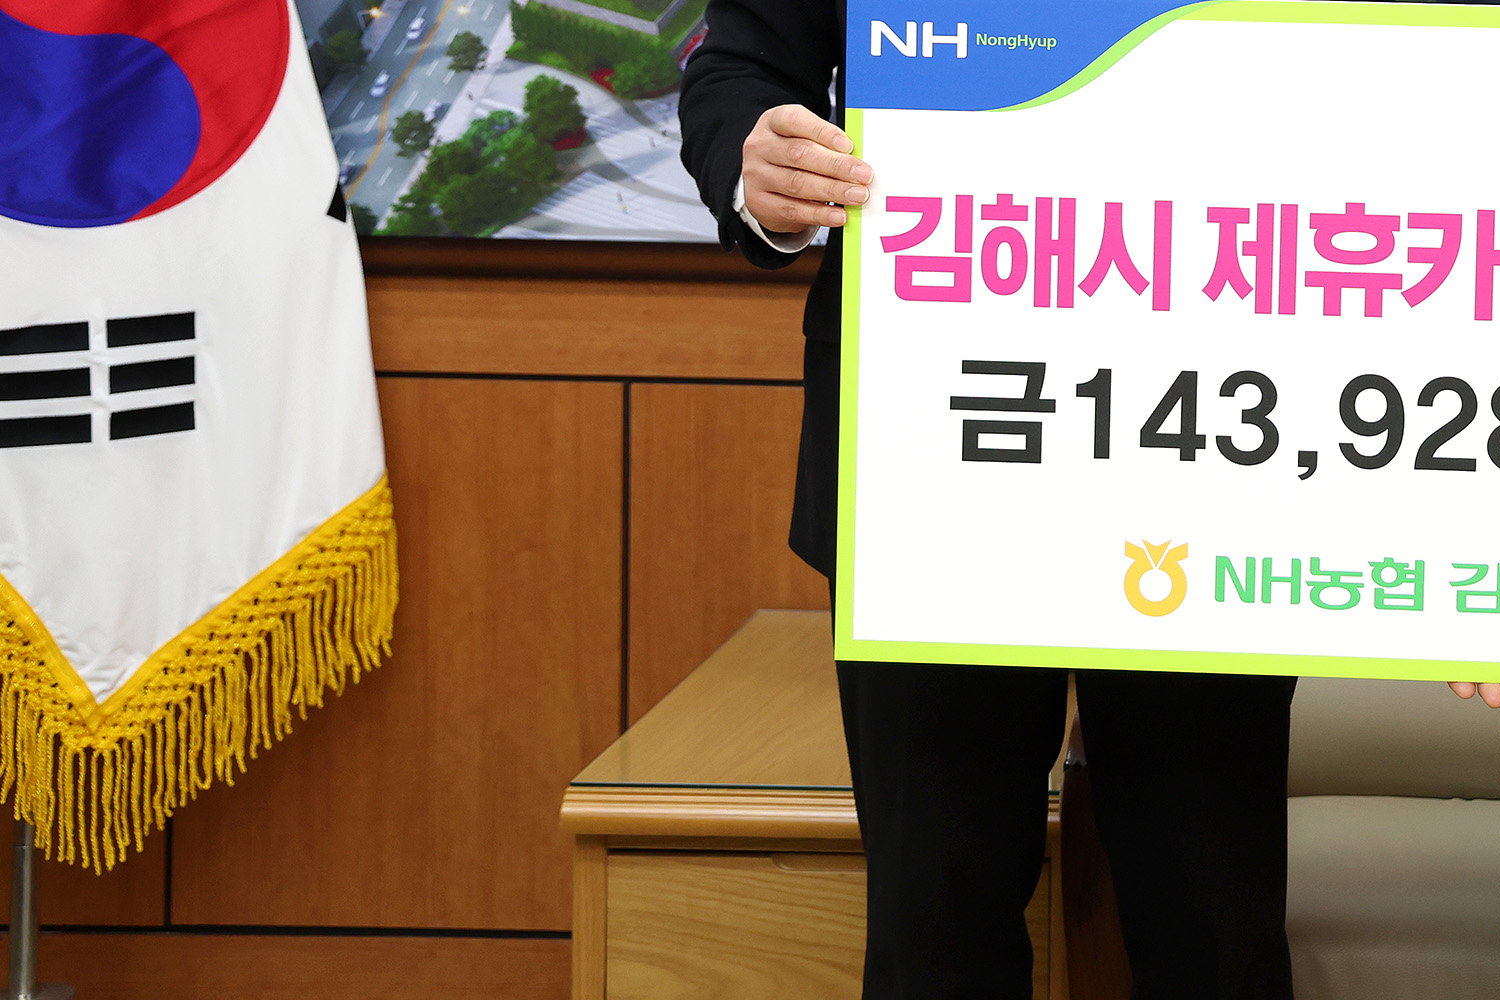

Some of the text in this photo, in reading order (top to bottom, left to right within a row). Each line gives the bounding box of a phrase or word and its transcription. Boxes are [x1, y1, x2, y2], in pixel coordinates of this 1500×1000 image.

[869, 19, 1058, 59] NH NongHyup
[879, 192, 1173, 312] 김해시
[1214, 554, 1426, 612] NH농협
